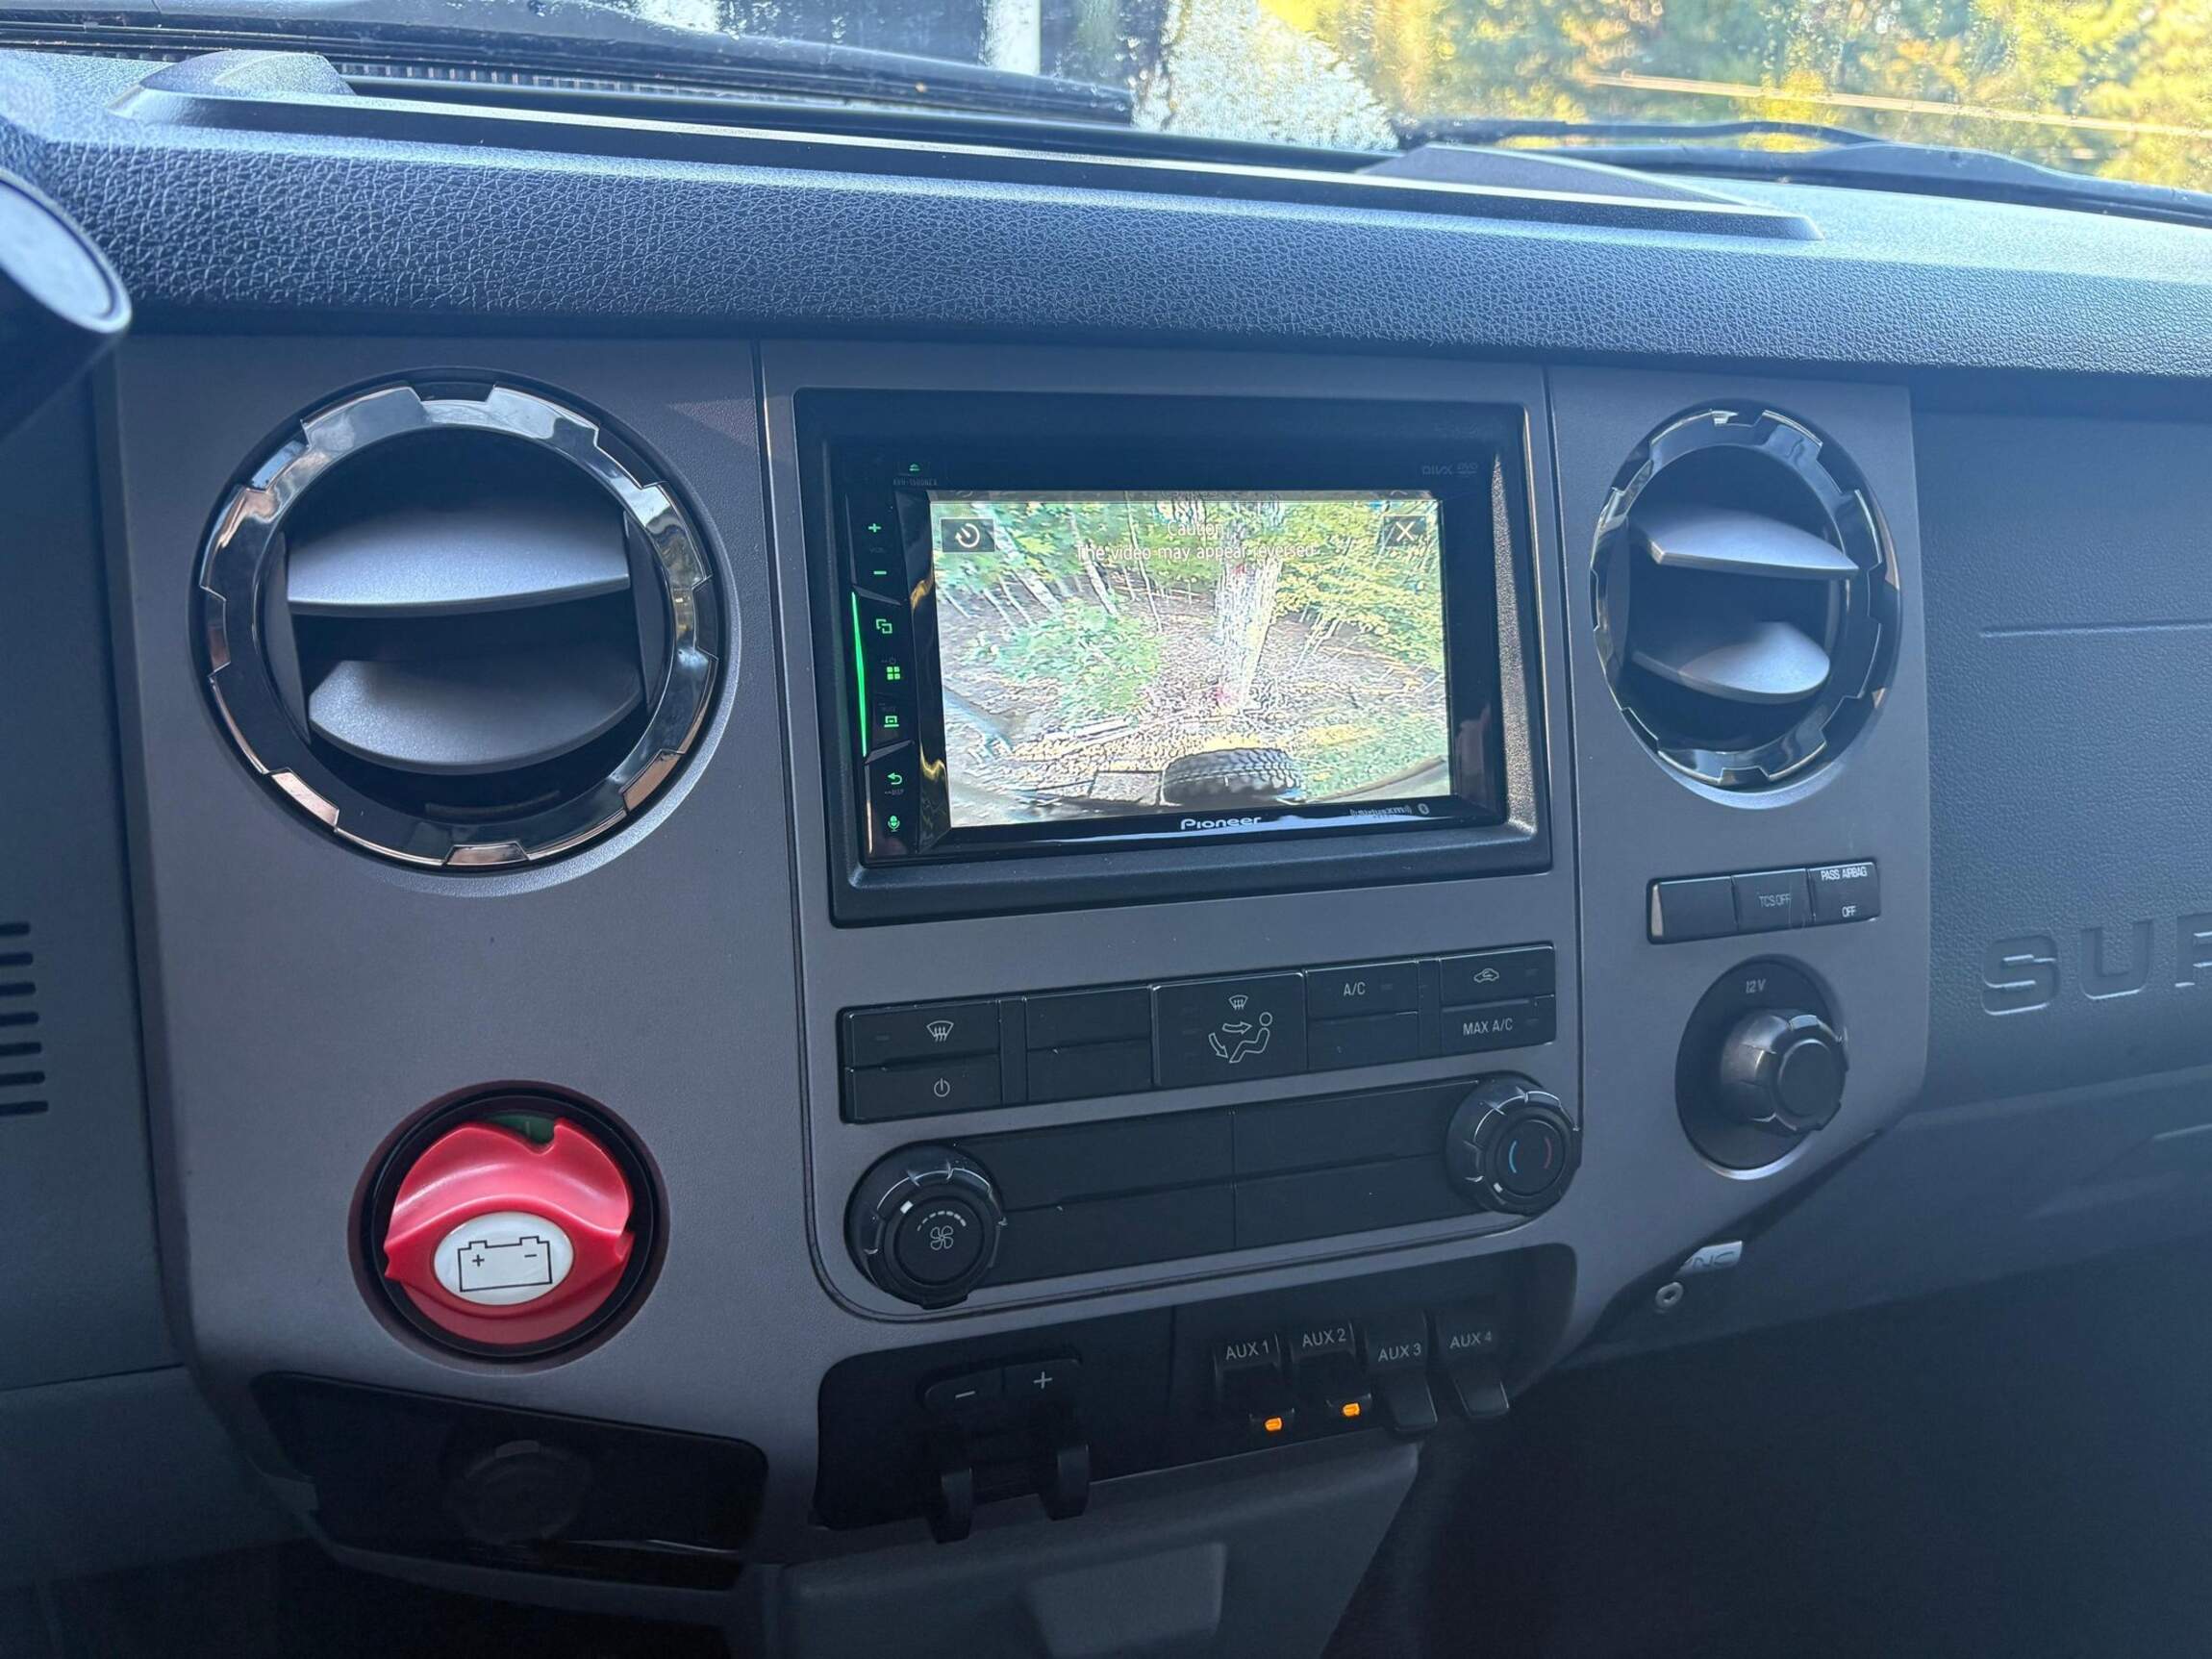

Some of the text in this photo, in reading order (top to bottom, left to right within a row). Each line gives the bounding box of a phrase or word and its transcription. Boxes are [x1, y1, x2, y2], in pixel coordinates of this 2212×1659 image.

[1167, 520, 1224, 538] Caution
[1075, 544, 1106, 561] The
[1112, 544, 1152, 561] video
[1159, 546, 1191, 563] may
[1196, 545, 1246, 562] appear
[1180, 815, 1263, 831] Pioneer
[1821, 866, 1868, 882] PASS AIRBAG
[1842, 905, 1857, 917] OFF
[1344, 981, 1367, 996] A/C
[1463, 1018, 1514, 1036] MAX A/C
[1302, 1327, 1346, 1347] AUX 2
[1449, 1330, 1493, 1348] AUX 4
[1225, 1340, 1269, 1360] AUX 1
[1377, 1343, 1421, 1362] AUX 3
